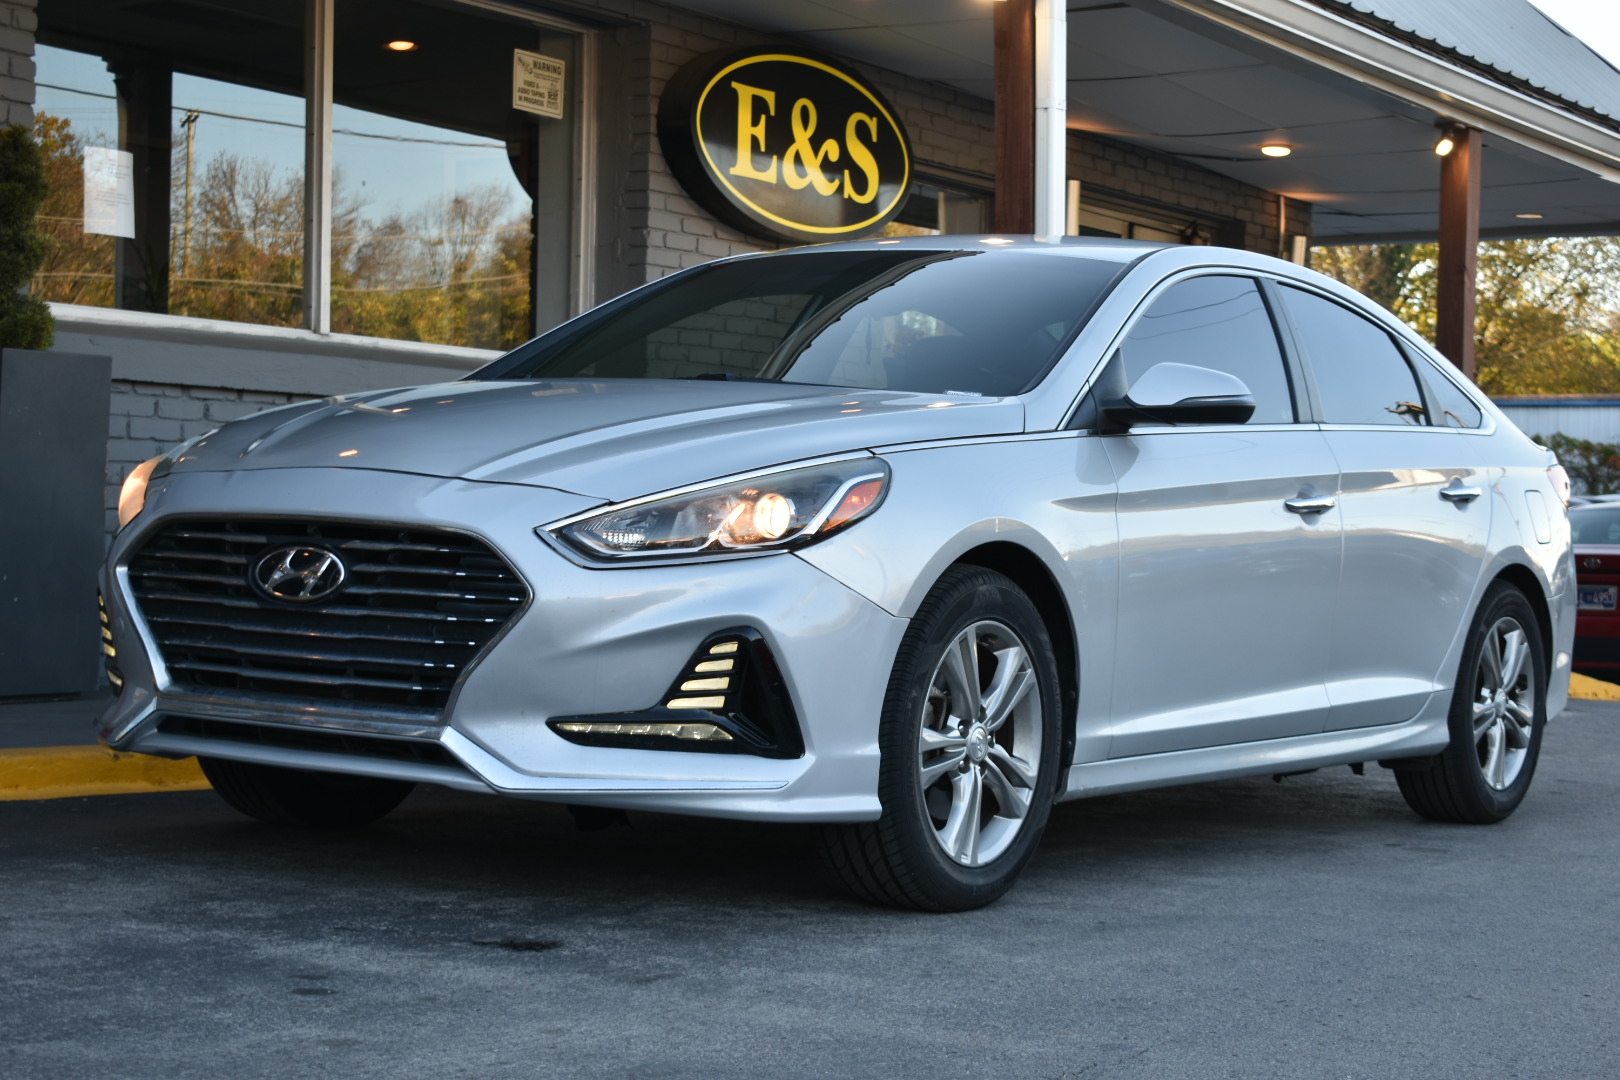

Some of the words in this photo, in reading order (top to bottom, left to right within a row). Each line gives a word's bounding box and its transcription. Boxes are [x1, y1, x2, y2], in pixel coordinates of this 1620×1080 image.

[532, 60, 562, 76] WARNING
[524, 80, 535, 88] VIDEO
[518, 86, 530, 96] AUDIO
[530, 89, 545, 99] TAPING
[524, 96, 544, 107] PROGRESS
[729, 81, 880, 204] E&S
